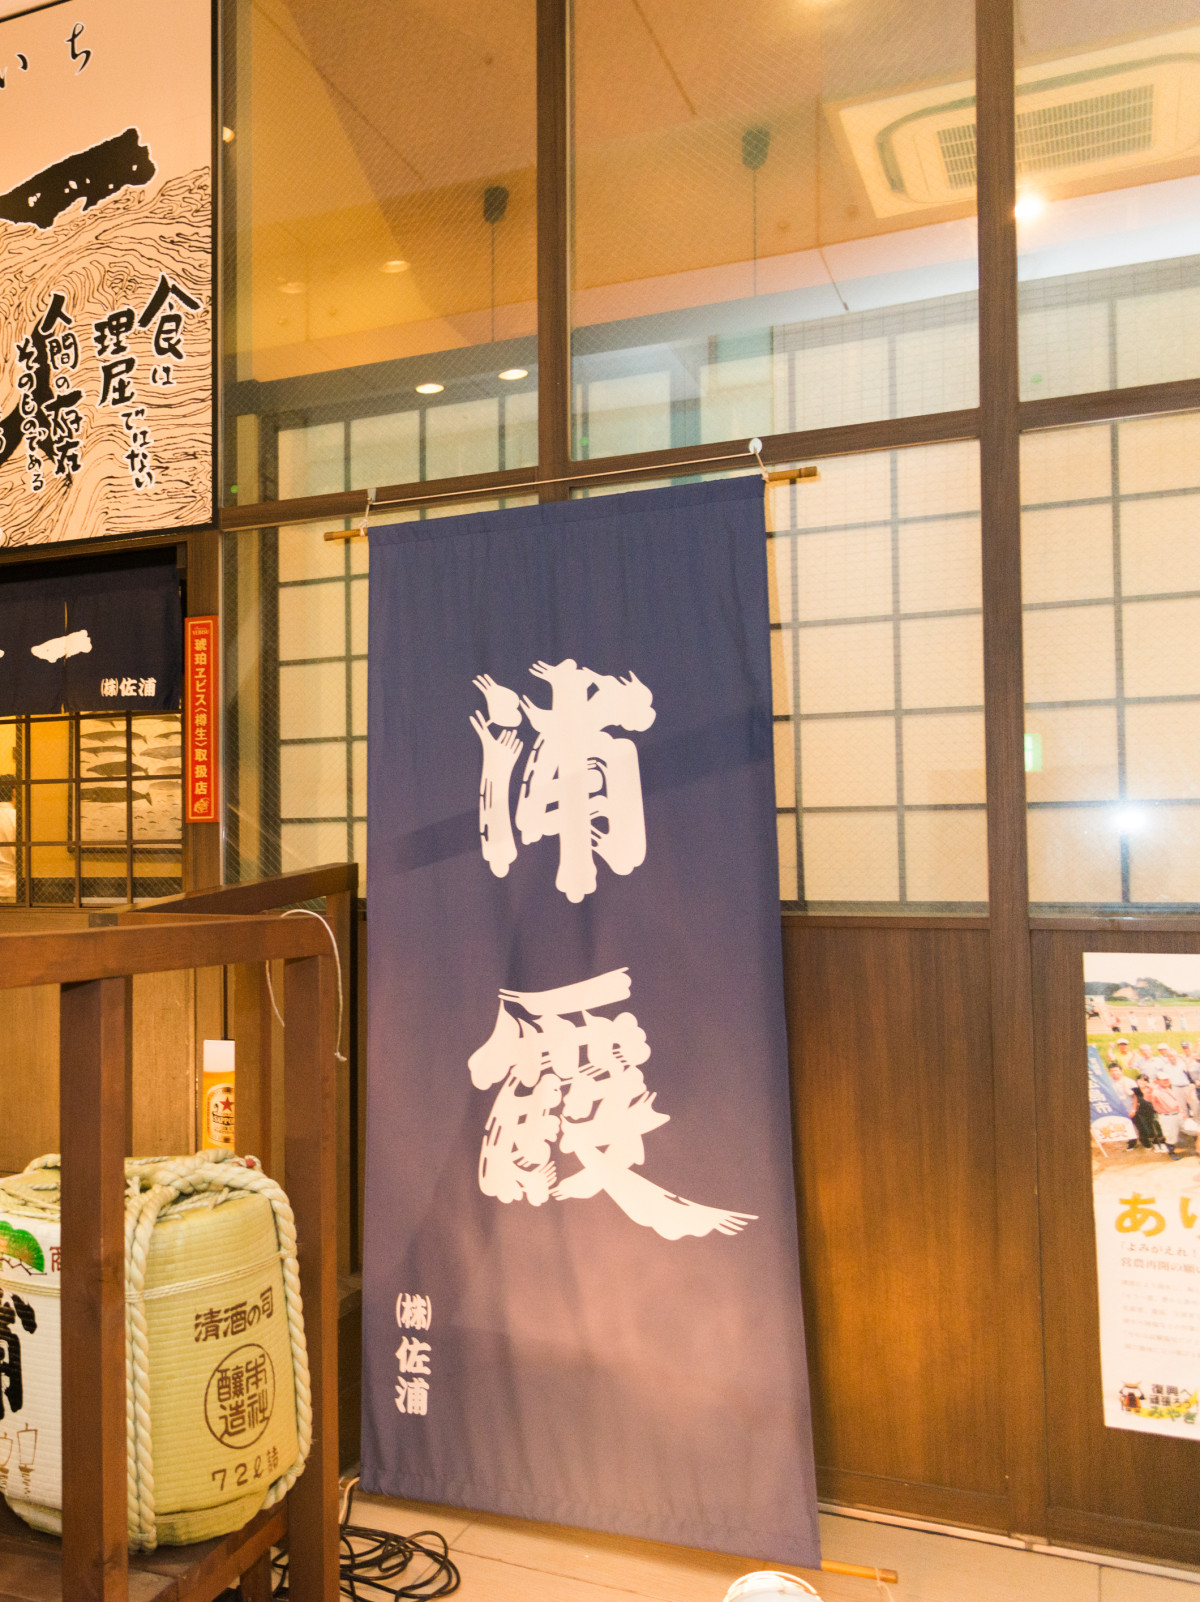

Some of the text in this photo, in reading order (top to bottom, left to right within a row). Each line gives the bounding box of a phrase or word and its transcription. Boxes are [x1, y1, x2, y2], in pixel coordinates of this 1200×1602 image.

[469, 658, 759, 1241] 浦霞
[194, 1286, 274, 1342] 清酒の司
